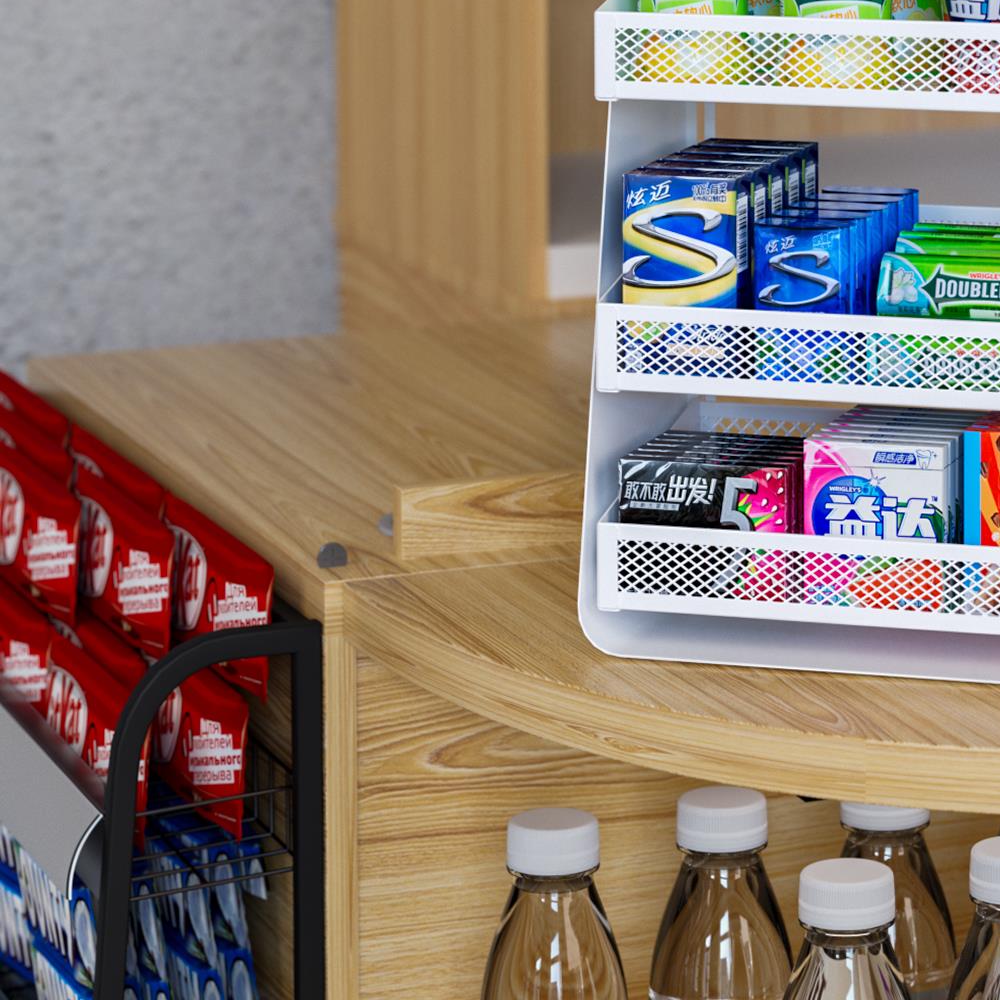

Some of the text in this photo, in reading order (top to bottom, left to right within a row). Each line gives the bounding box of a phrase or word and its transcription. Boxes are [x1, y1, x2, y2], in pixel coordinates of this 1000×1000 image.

[626, 180, 672, 209] 炫迈
[765, 234, 797, 254] 炫迈
[719, 476, 757, 531] 5
[828, 485, 862, 493] WRIGLEY'S
[824, 495, 938, 541] 益达
